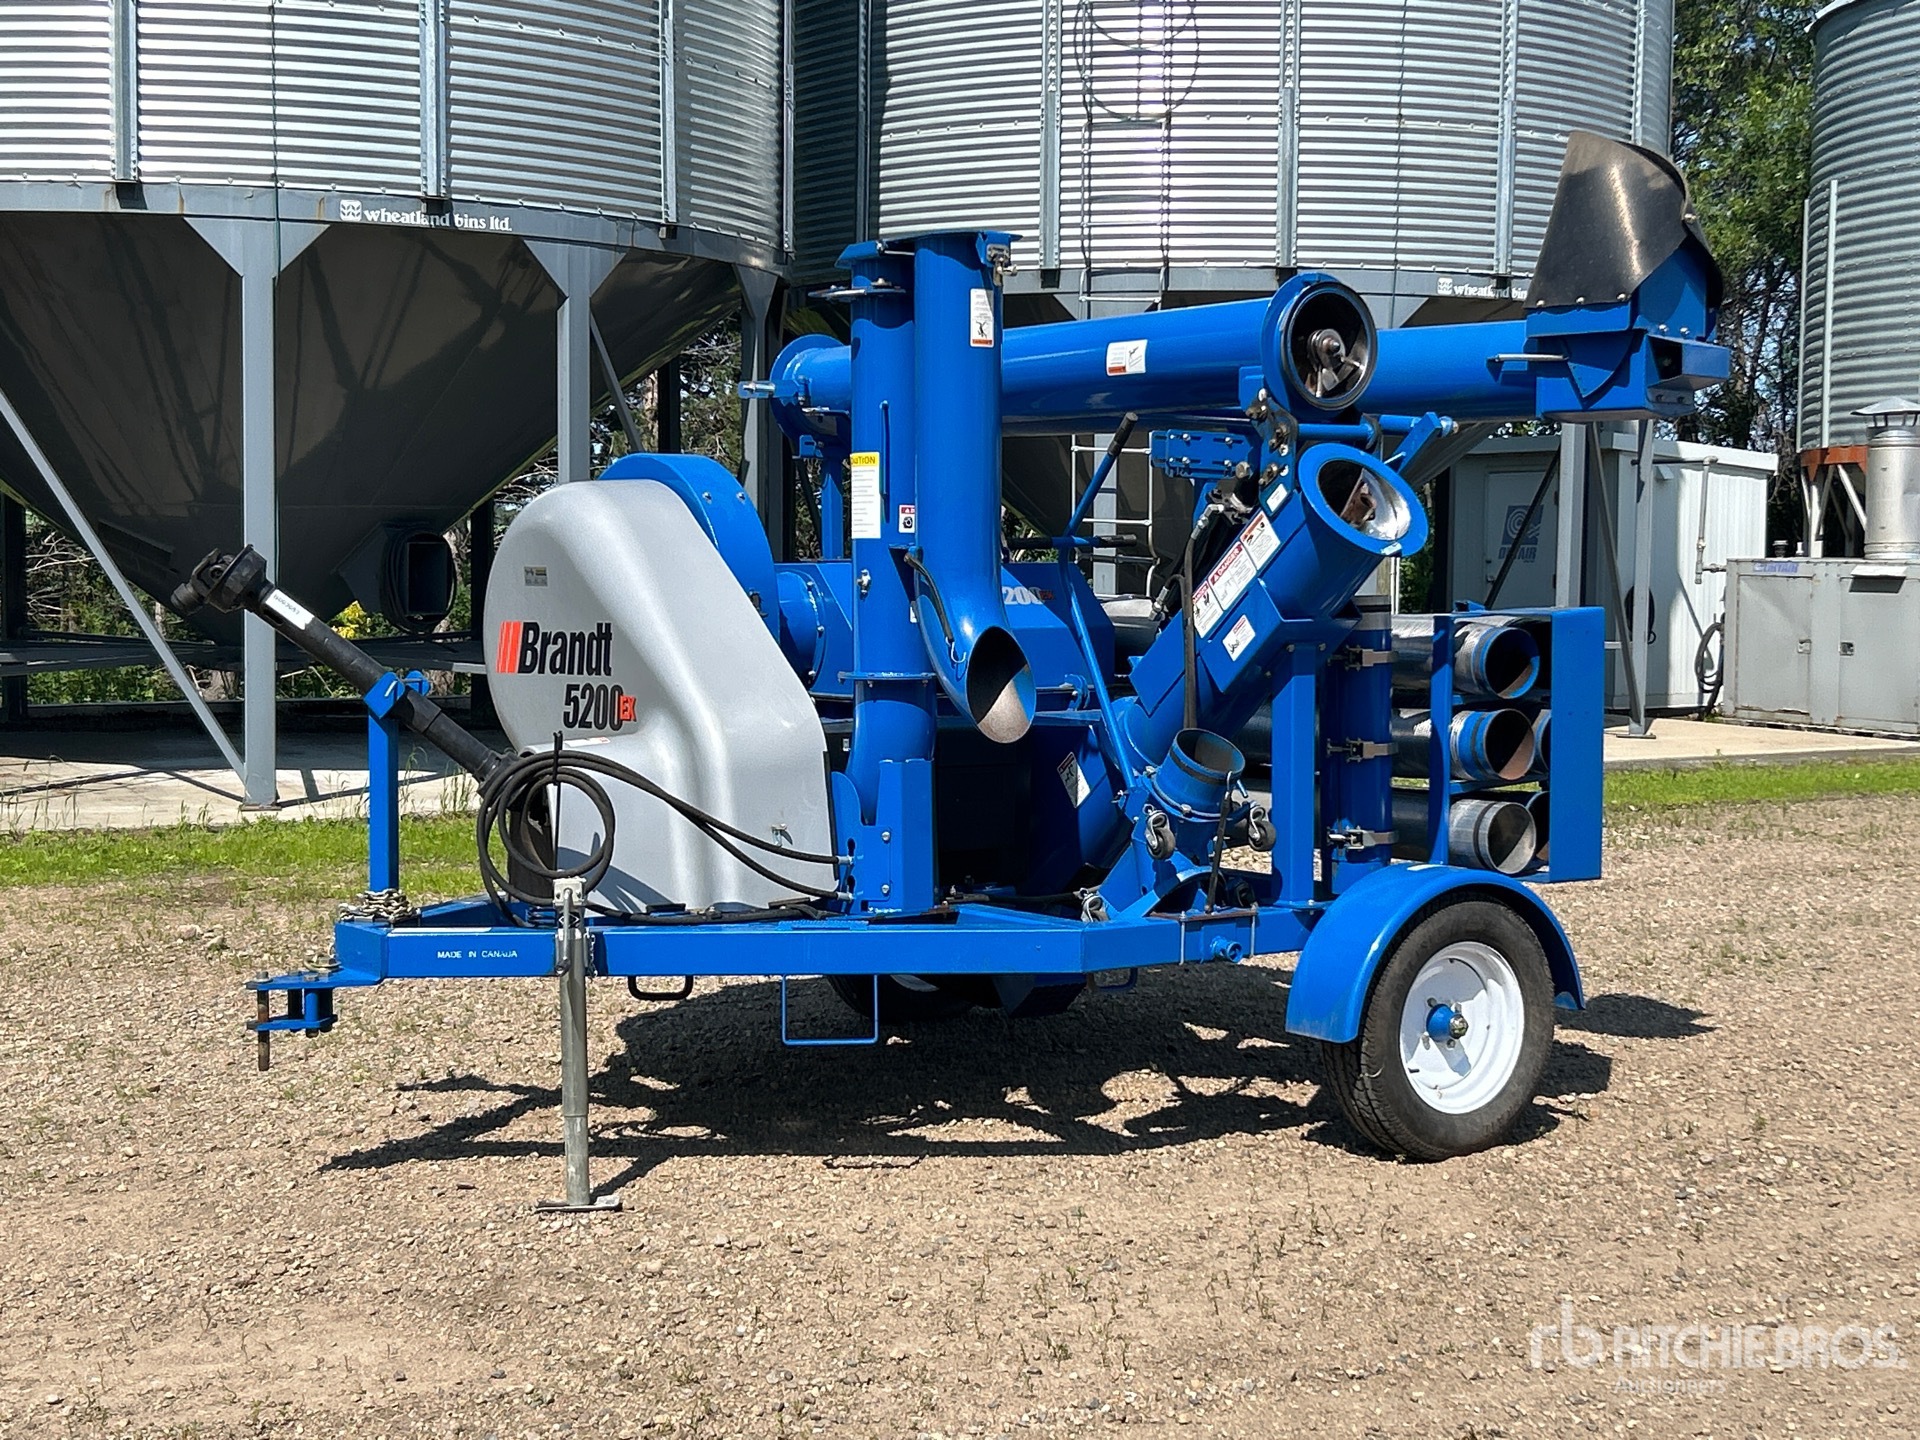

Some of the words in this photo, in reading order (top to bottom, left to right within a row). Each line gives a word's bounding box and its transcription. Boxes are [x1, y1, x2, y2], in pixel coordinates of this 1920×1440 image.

[363, 207, 450, 227] wheatland
[454, 213, 487, 229] bins
[489, 215, 512, 231] ltd.
[517, 622, 613, 676] Brandt
[437, 950, 462, 959] MADE
[468, 950, 477, 958] IN
